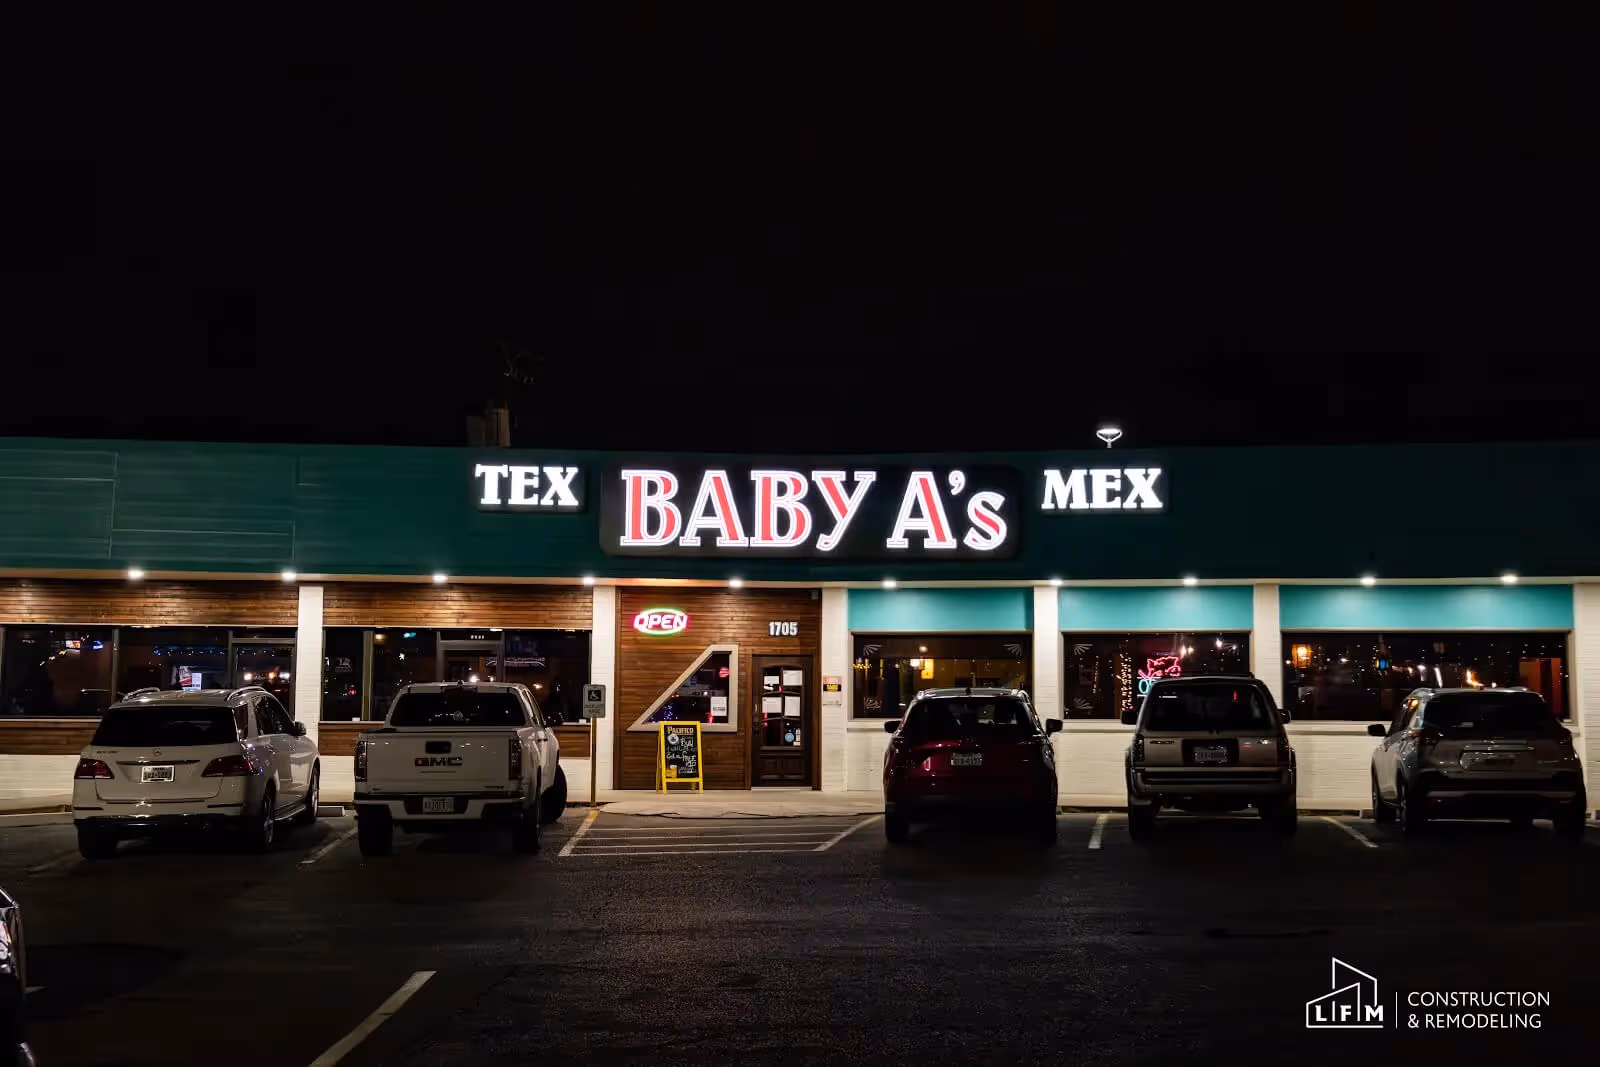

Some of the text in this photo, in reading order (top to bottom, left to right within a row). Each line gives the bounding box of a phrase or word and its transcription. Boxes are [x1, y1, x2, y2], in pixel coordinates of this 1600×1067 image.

[475, 464, 578, 505] TEX
[1042, 469, 1162, 508] MEX
[620, 470, 1006, 550] BABY A's
[633, 613, 688, 630] OPEN
[768, 621, 799, 636] 1705
[414, 757, 463, 767] GMC
